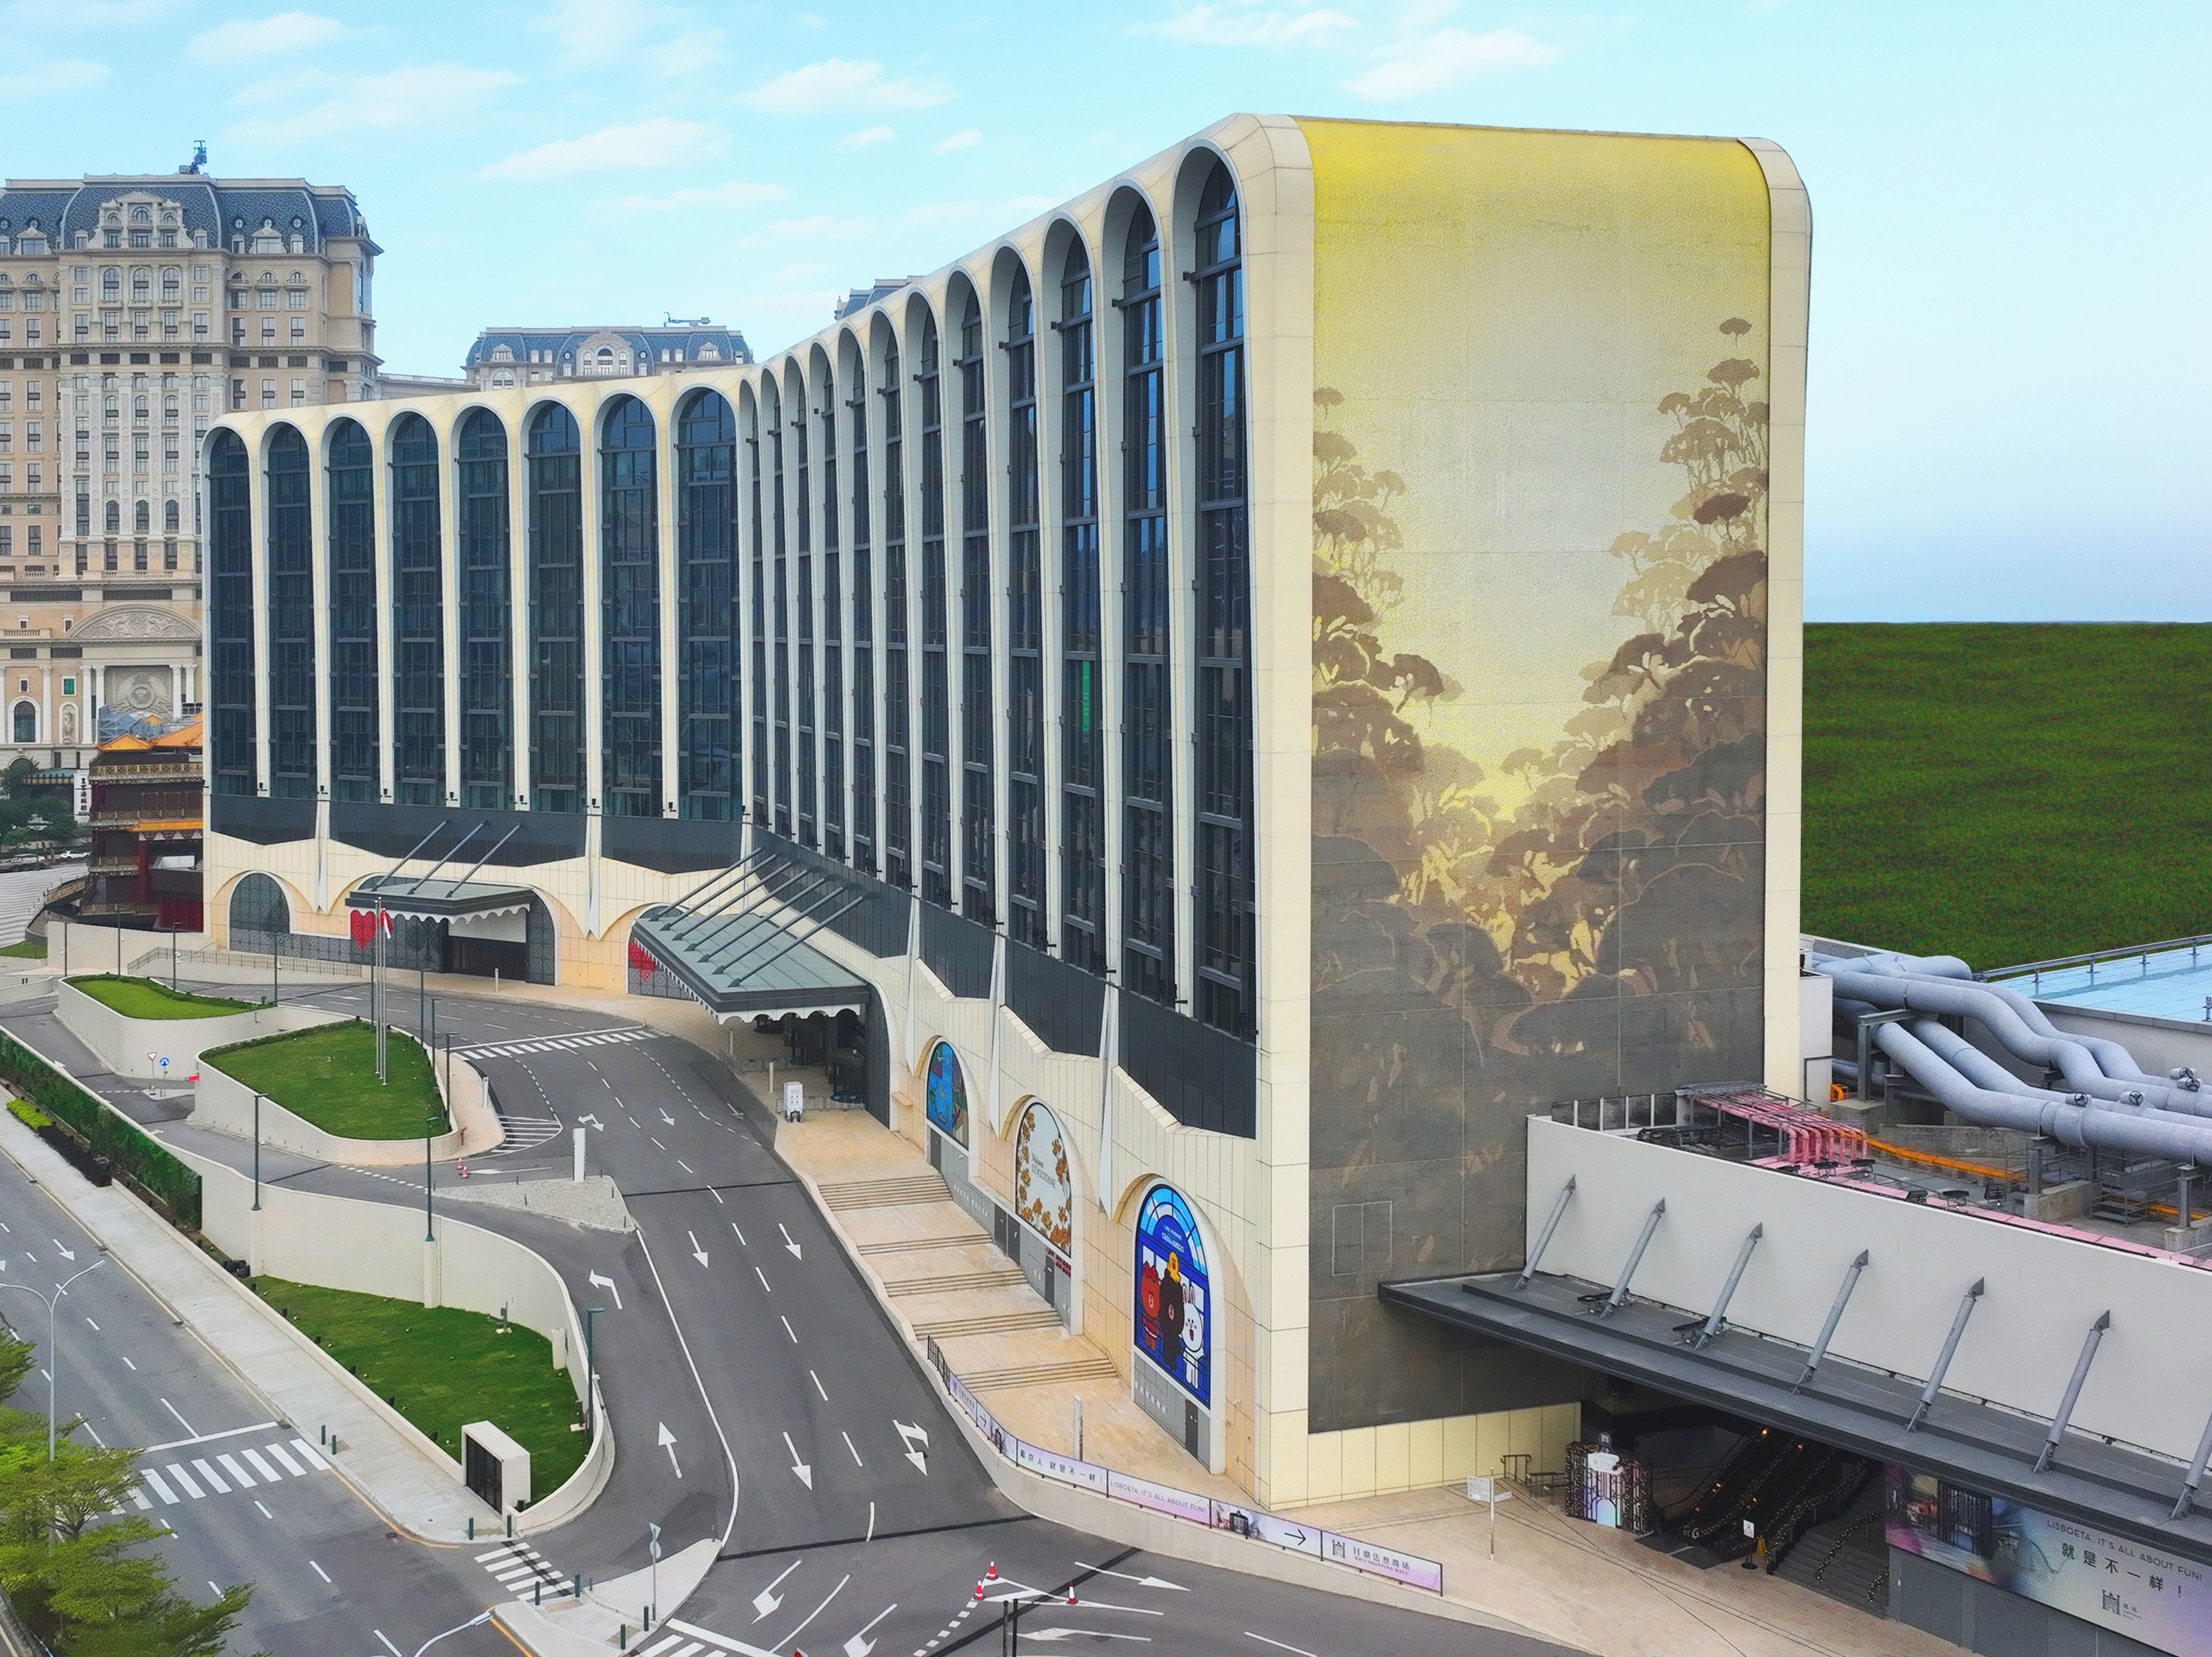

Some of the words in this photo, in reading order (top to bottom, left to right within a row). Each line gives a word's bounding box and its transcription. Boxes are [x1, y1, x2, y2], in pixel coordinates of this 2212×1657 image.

[1167, 1498, 1188, 1508] ABOUT
[1191, 1504, 1206, 1512] FUN!
[2098, 1538, 2114, 1549] IT'S
[2118, 1545, 2135, 1557] ALL
[2140, 1554, 2174, 1571] ABOUT
[2178, 1566, 2202, 1582] FUN!
